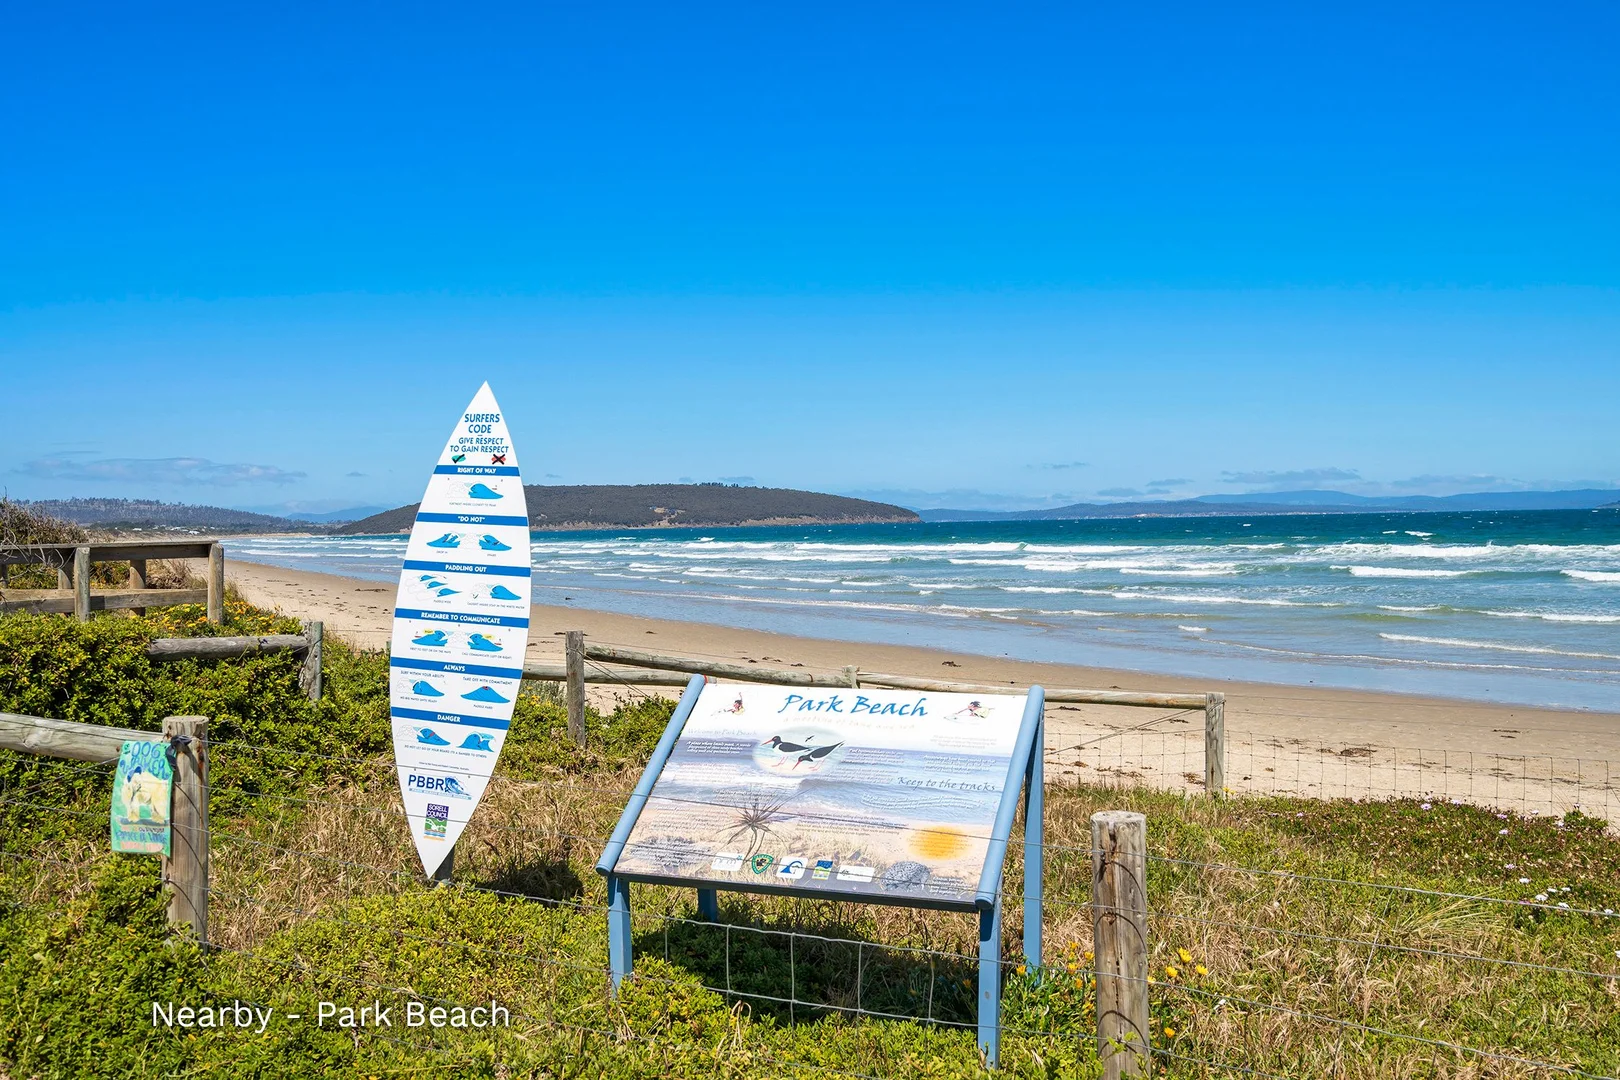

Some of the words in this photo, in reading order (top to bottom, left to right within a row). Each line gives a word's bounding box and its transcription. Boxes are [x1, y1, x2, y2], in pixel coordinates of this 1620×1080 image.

[464, 414, 500, 422] SURFERS
[468, 424, 492, 434] CODE
[460, 615, 501, 624] COMMUNICATE
[778, 695, 843, 714] Park
[850, 696, 928, 716] Beach
[437, 714, 461, 722] DANGER
[898, 776, 923, 790] Keep
[939, 777, 956, 789] the
[960, 781, 995, 791] tracks
